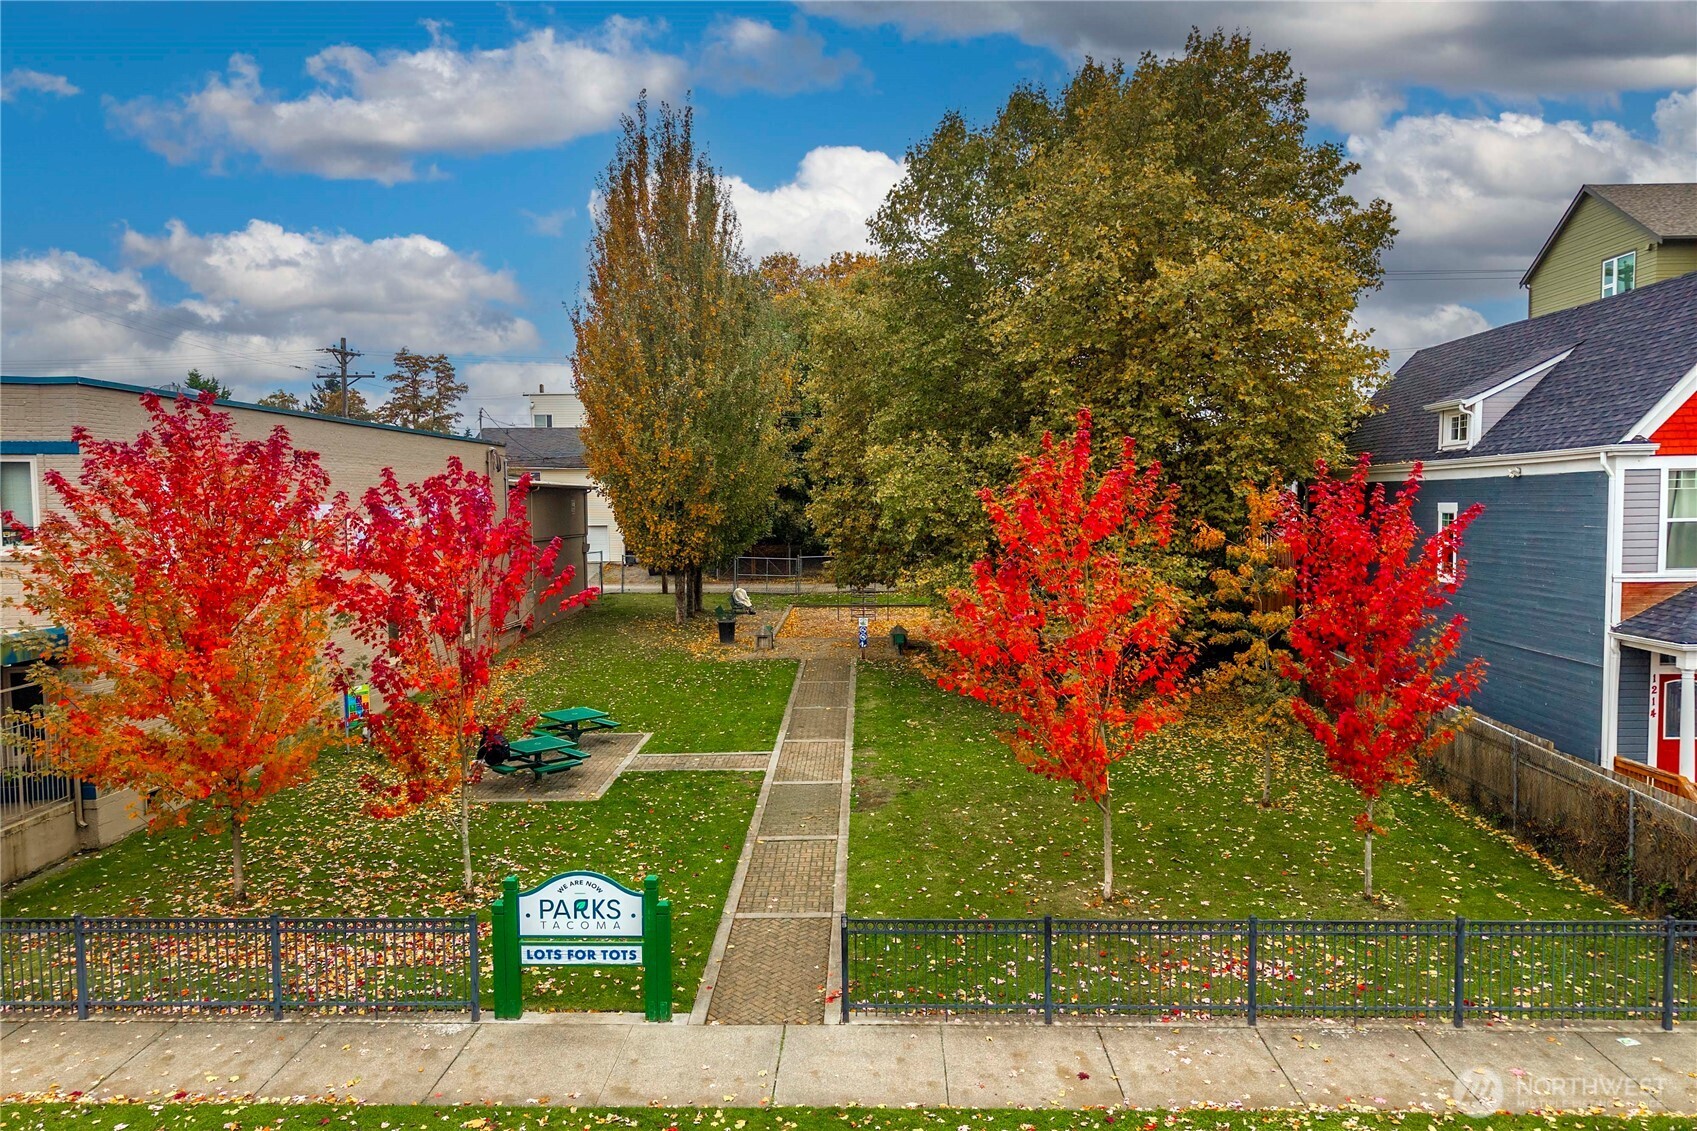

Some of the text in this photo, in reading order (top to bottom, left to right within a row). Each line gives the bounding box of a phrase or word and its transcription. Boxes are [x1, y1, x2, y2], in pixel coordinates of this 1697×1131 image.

[557, 884, 568, 893] WE
[585, 881, 603, 893] NOW
[539, 898, 621, 919] PARKS
[540, 921, 621, 929] TACOMA
[526, 949, 637, 960] LOTS FOR TOTS
